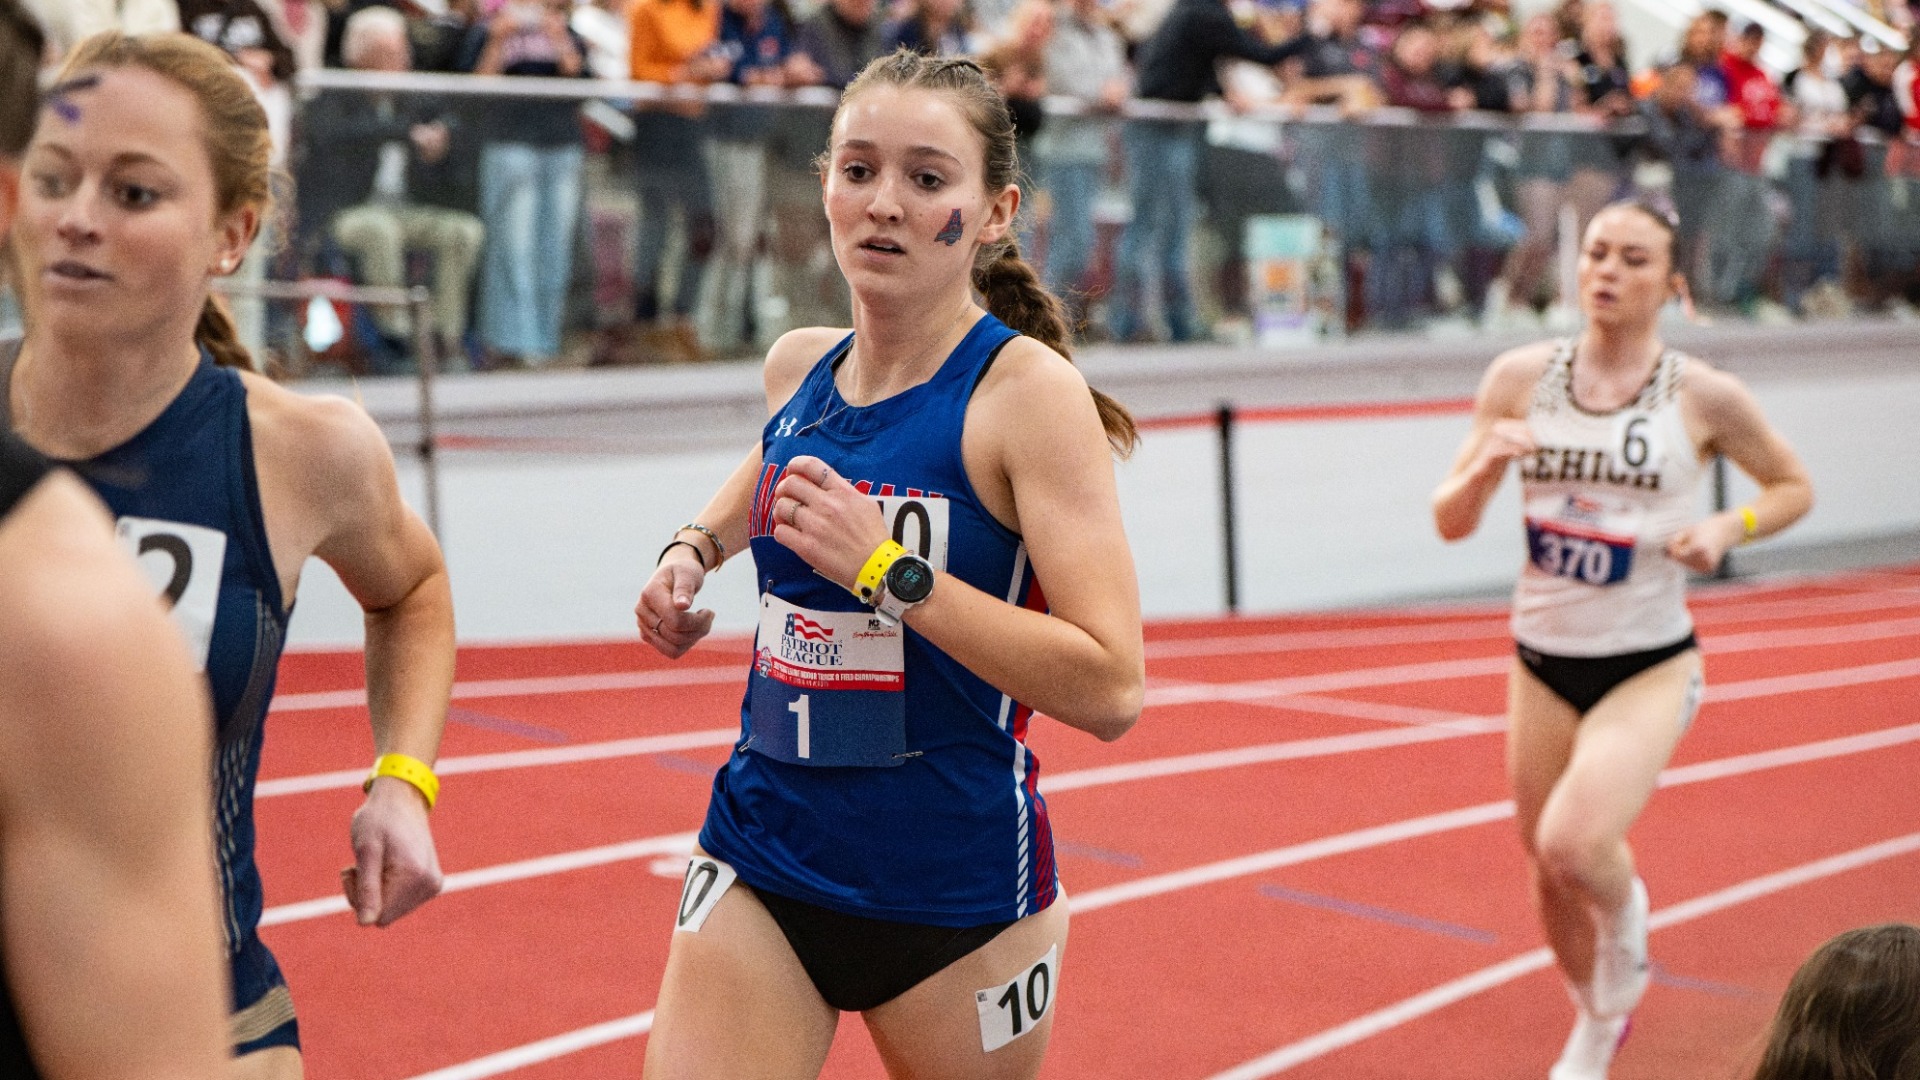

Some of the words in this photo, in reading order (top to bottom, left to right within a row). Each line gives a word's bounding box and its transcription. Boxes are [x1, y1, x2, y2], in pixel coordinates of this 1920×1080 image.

[1624, 418, 1648, 467] 6
[1538, 533, 1613, 584] 370
[781, 634, 843, 655] PATRIOT
[781, 645, 843, 666] LEAGUE
[788, 694, 810, 759] 1
[998, 962, 1049, 1036] 10
